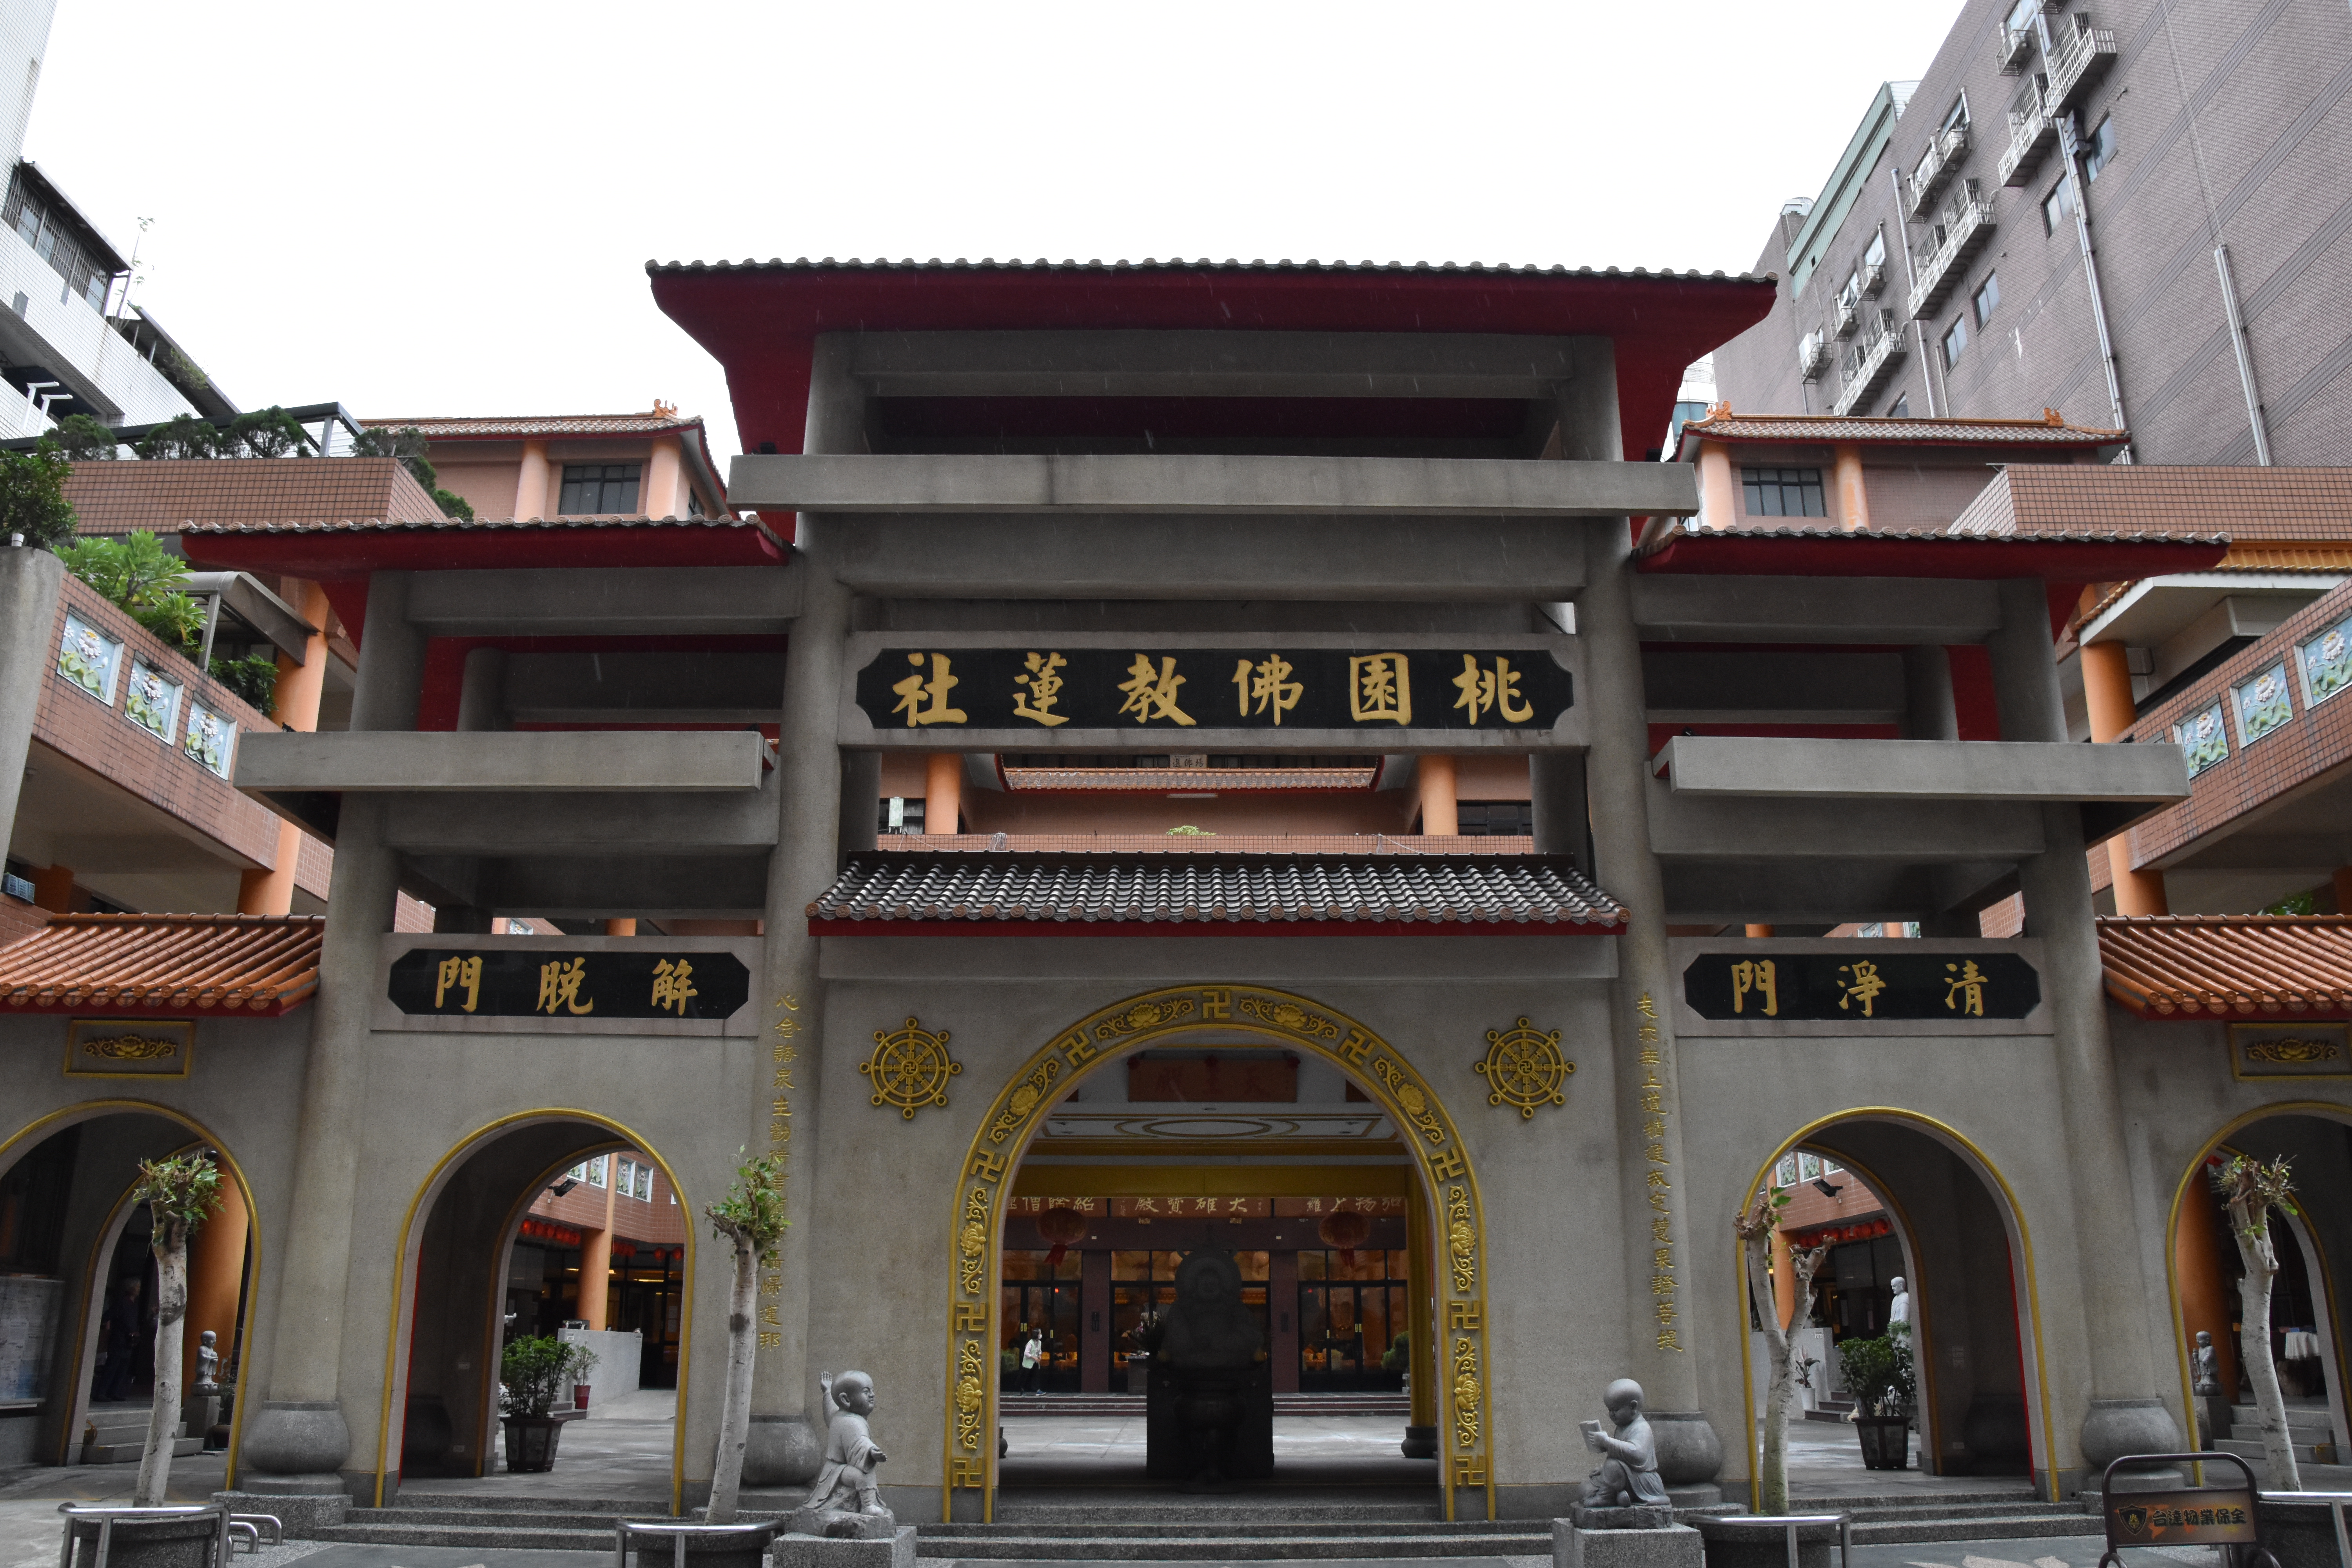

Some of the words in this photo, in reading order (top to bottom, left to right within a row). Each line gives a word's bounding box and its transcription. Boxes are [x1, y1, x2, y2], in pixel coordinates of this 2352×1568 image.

[890, 651, 1534, 727] 桃園佛教蓮社
[1730, 959, 1989, 1017] 清淨門
[2152, 1508, 2247, 1526] 台達物業保全
